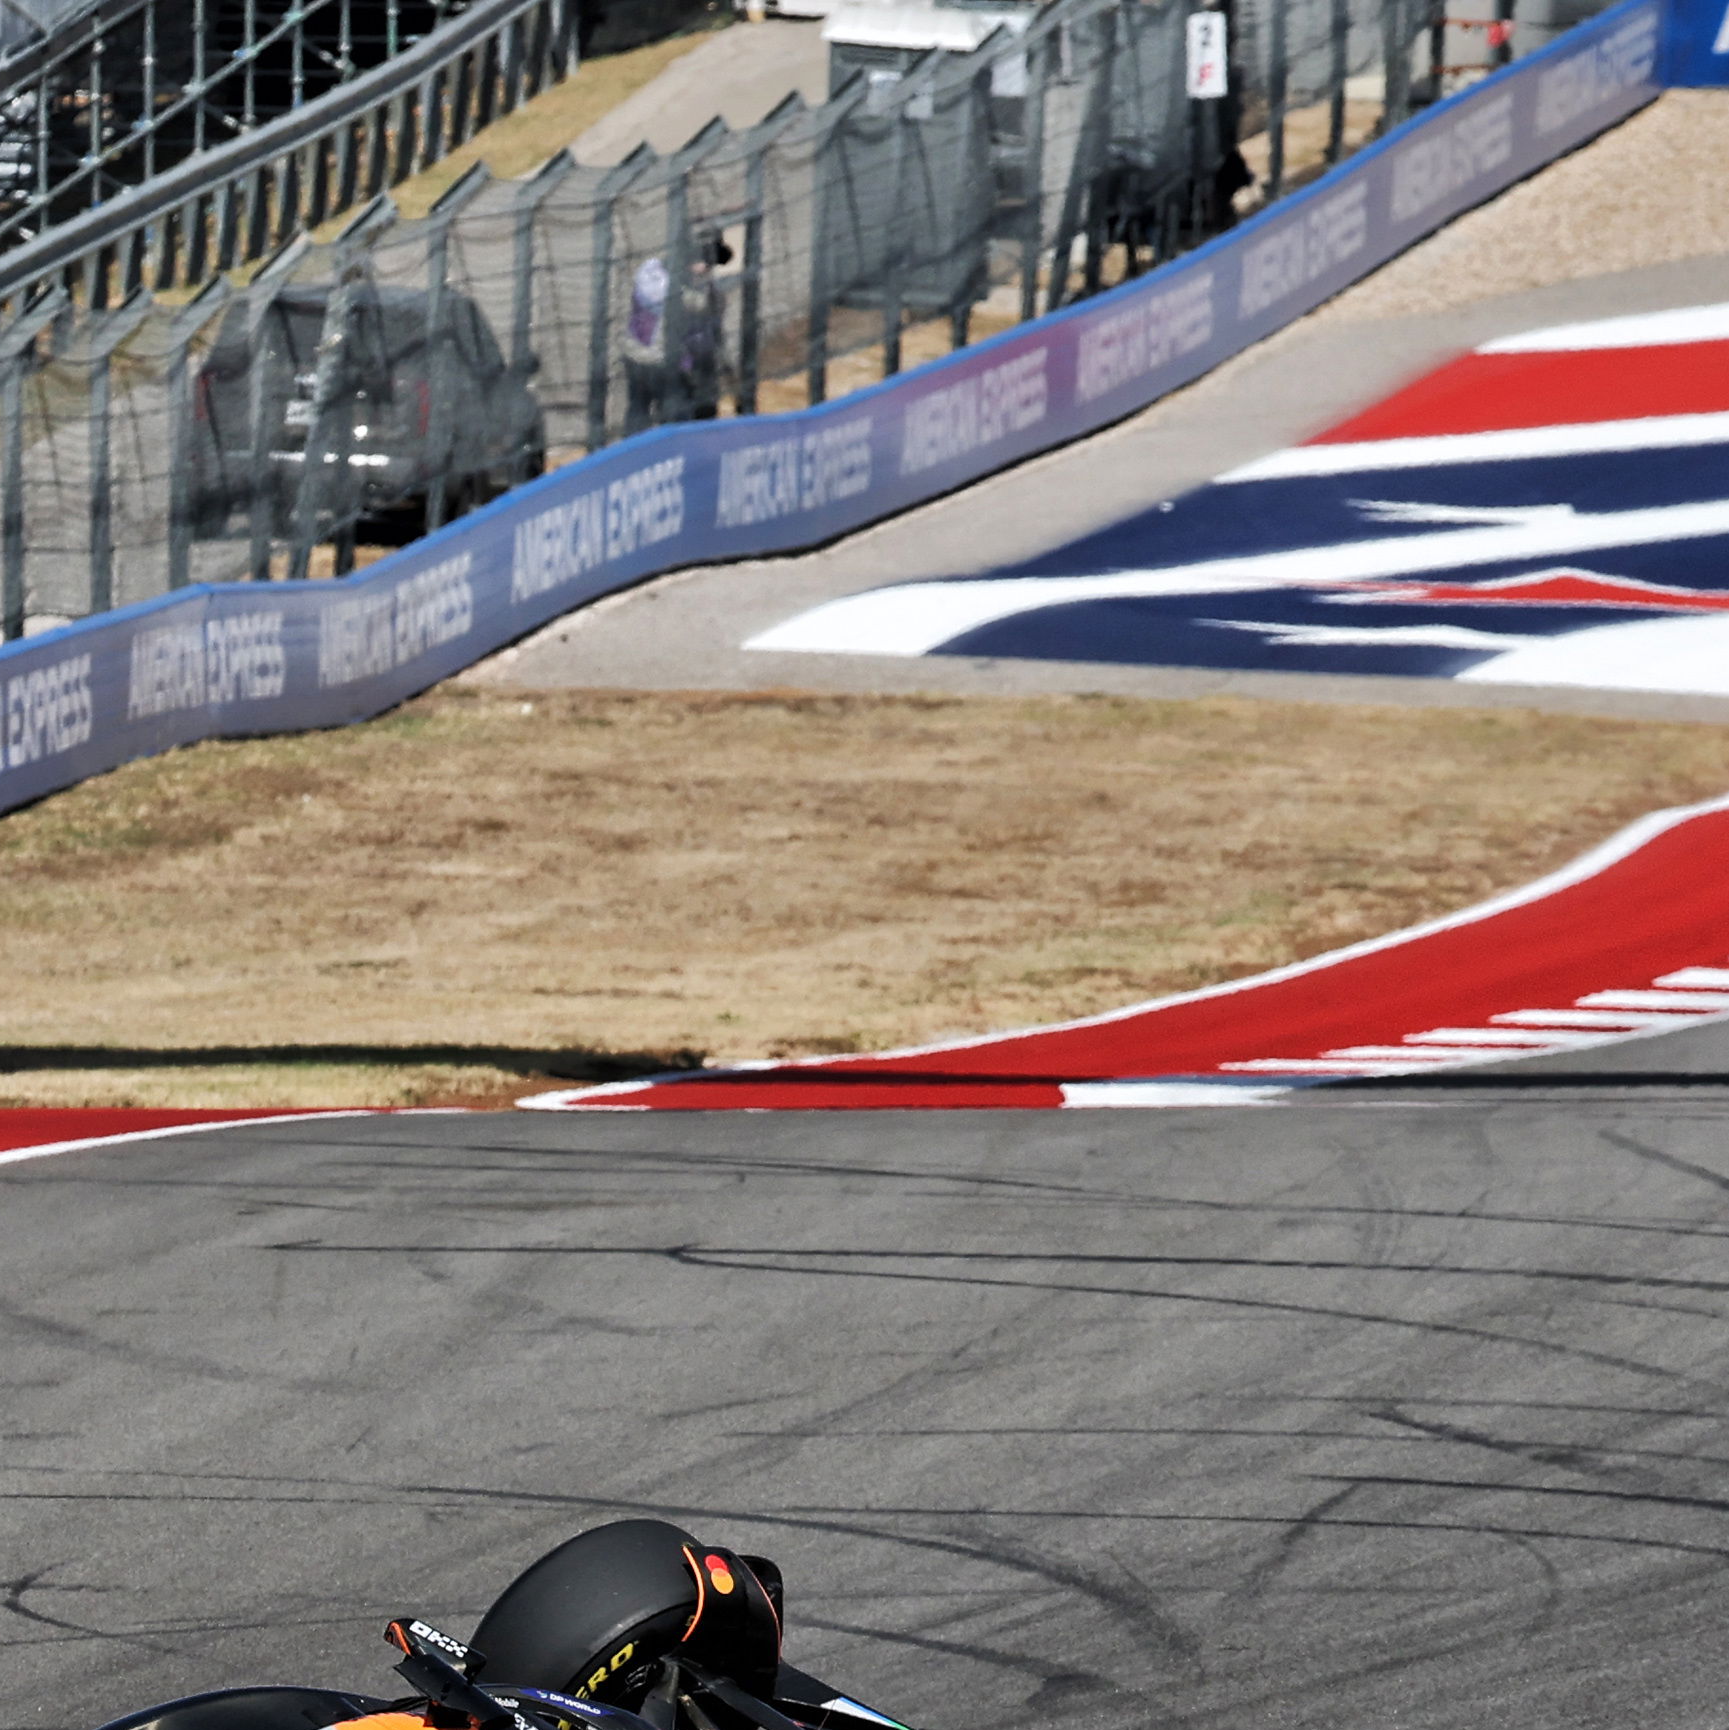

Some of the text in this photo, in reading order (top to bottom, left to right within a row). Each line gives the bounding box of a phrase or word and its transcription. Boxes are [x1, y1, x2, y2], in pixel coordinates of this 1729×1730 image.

[511, 455, 686, 606] AMERICAN EXPRESS
[7, 652, 94, 765] EXPRESS
[549, 1692, 601, 1715] DP WORLD
